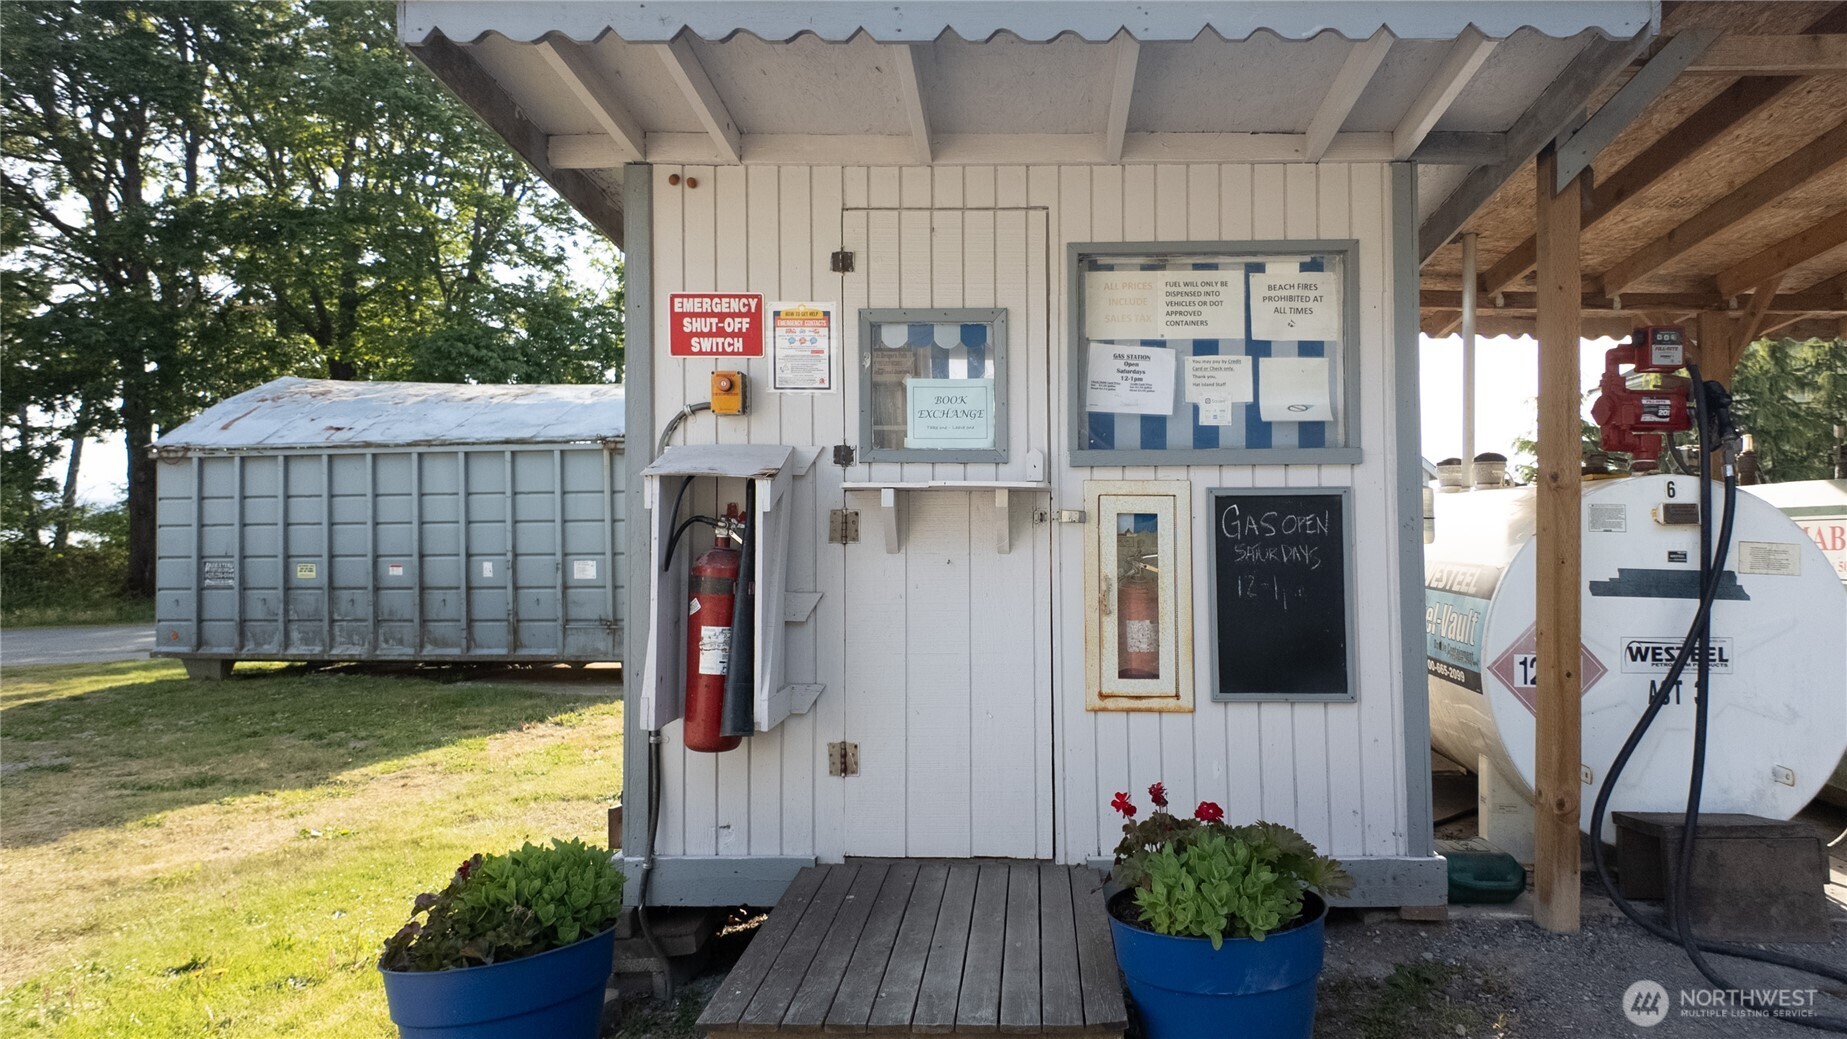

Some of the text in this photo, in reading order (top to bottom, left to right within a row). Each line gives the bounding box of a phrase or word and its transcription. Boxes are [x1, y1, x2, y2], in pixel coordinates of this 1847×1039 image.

[1103, 282, 1153, 291] ALL PRICES
[1267, 283, 1318, 292] BEACH FIRES
[674, 298, 758, 312] EMERGENCY
[1108, 298, 1148, 306] INCLUDE
[1262, 295, 1324, 303] PROHIBITED AT
[1289, 307, 1314, 315] TIMES
[683, 317, 750, 332] SHUT-OFF
[1104, 314, 1152, 323] SALES TAX
[690, 337, 743, 352] SWITCH
[934, 395, 968, 405] BOOK
[918, 408, 985, 420] EXCHANGE
[1667, 480, 1676, 498] 6
[1221, 504, 1329, 540] GAS OPEN
[1803, 525, 1846, 551] AB
[1234, 544, 1321, 570] SATURDAYS
